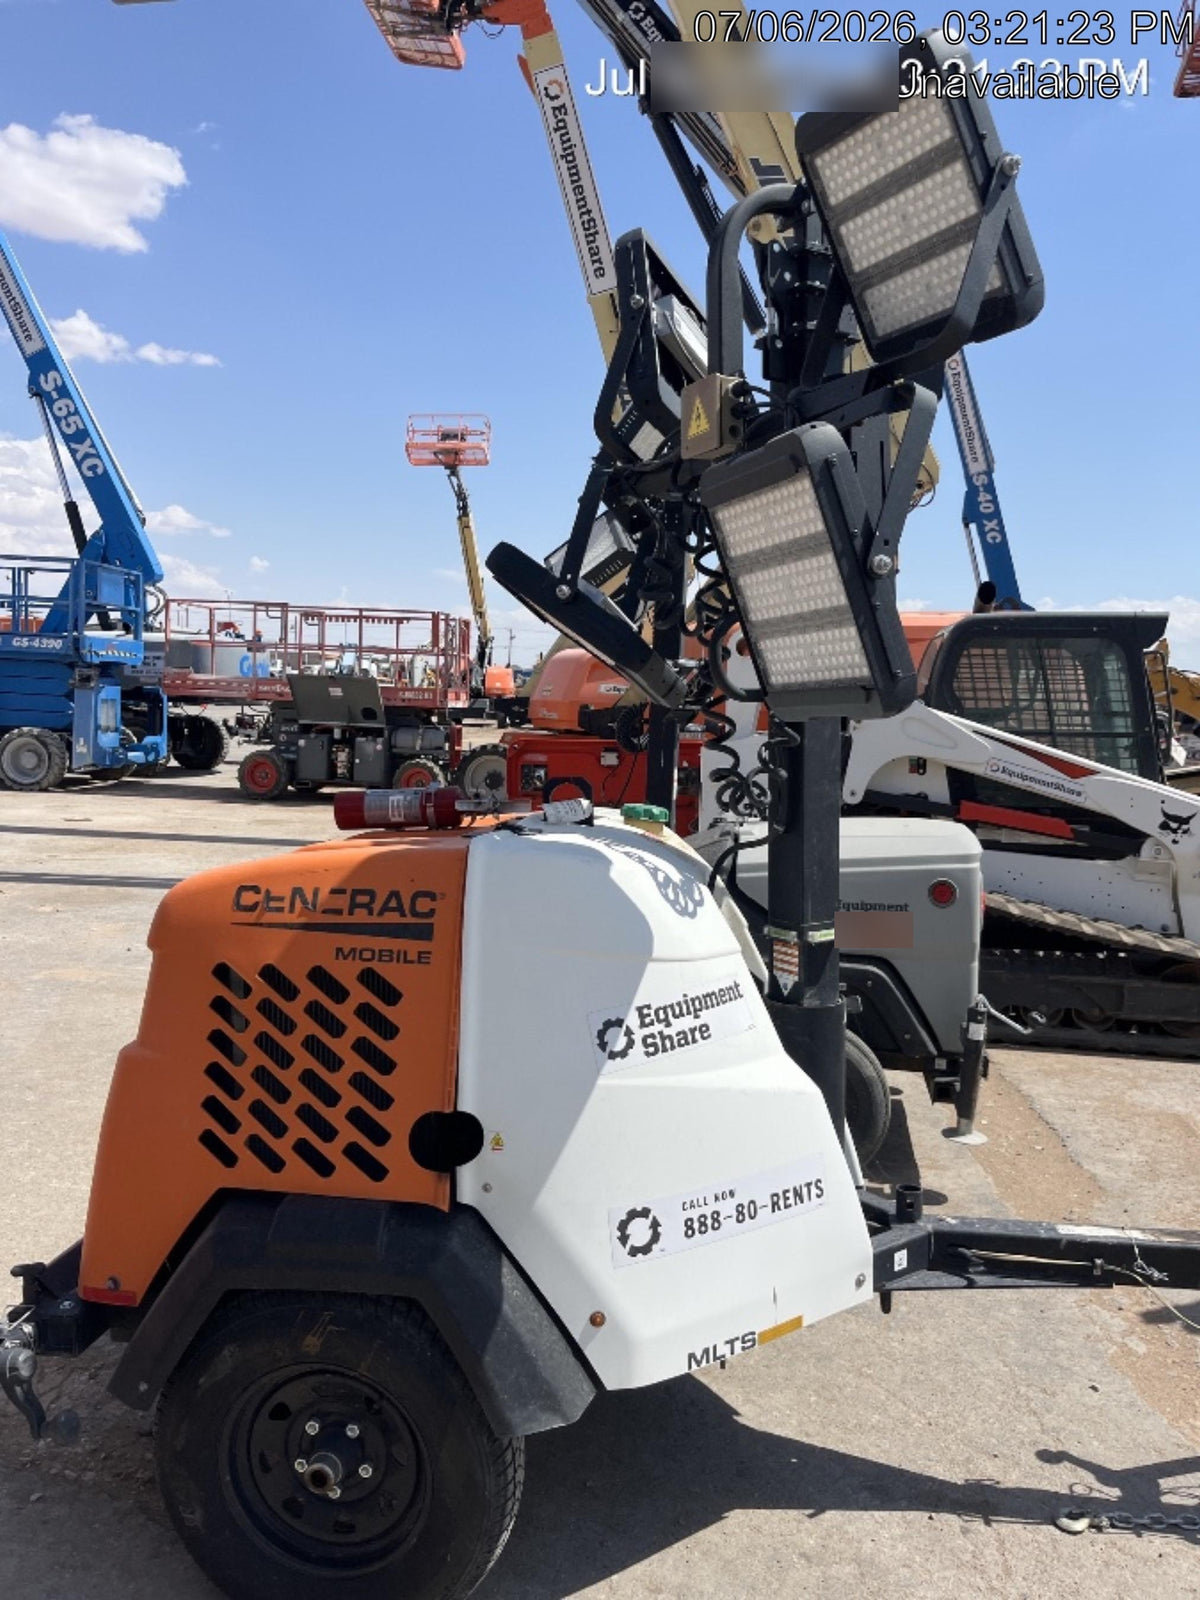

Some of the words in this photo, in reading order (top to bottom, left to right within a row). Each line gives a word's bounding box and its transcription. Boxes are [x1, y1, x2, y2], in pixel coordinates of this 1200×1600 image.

[550, 102, 606, 280] EquipmentShare
[39, 370, 85, 434] S-65
[68, 438, 104, 477] XC
[972, 473, 995, 514] S-40
[982, 519, 1002, 544] XC
[334, 946, 433, 965] MOBILE
[635, 980, 744, 1029] Equipment
[641, 1022, 712, 1059] Share
[681, 1195, 709, 1212] CALL
[713, 1188, 737, 1203] NOW
[683, 1178, 825, 1239] 888-80-RENTS
[687, 1330, 757, 1372] MLTS
